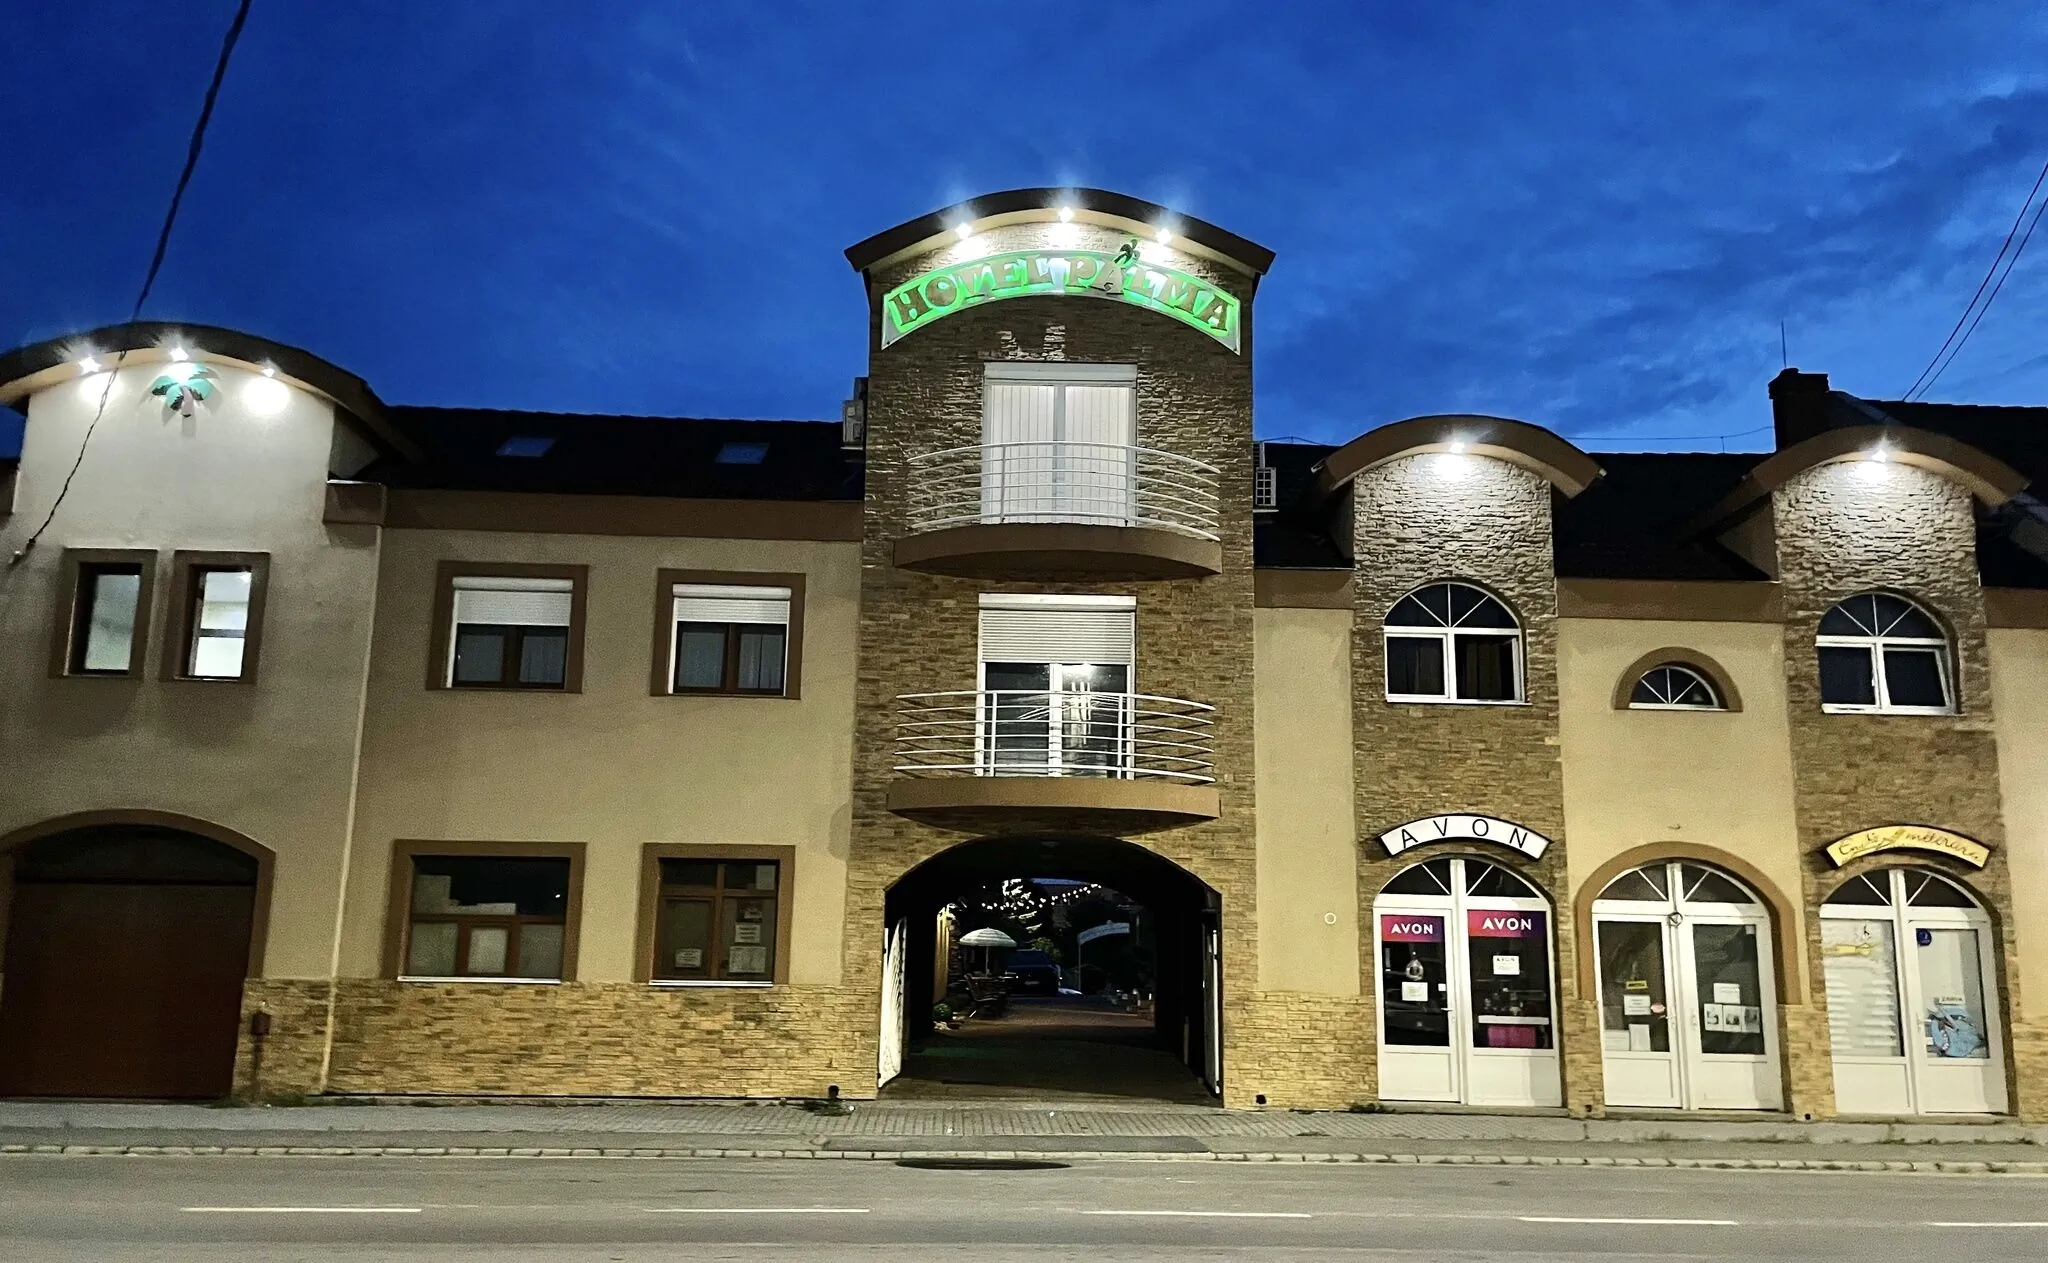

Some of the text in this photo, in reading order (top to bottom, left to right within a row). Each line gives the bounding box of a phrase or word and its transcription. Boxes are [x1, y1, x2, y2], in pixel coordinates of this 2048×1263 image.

[889, 253, 1235, 331] HOTEL PALMA
[1401, 818, 1528, 849] AVON
[1391, 923, 1434, 935] AVON
[1482, 917, 1533, 931] AVON
